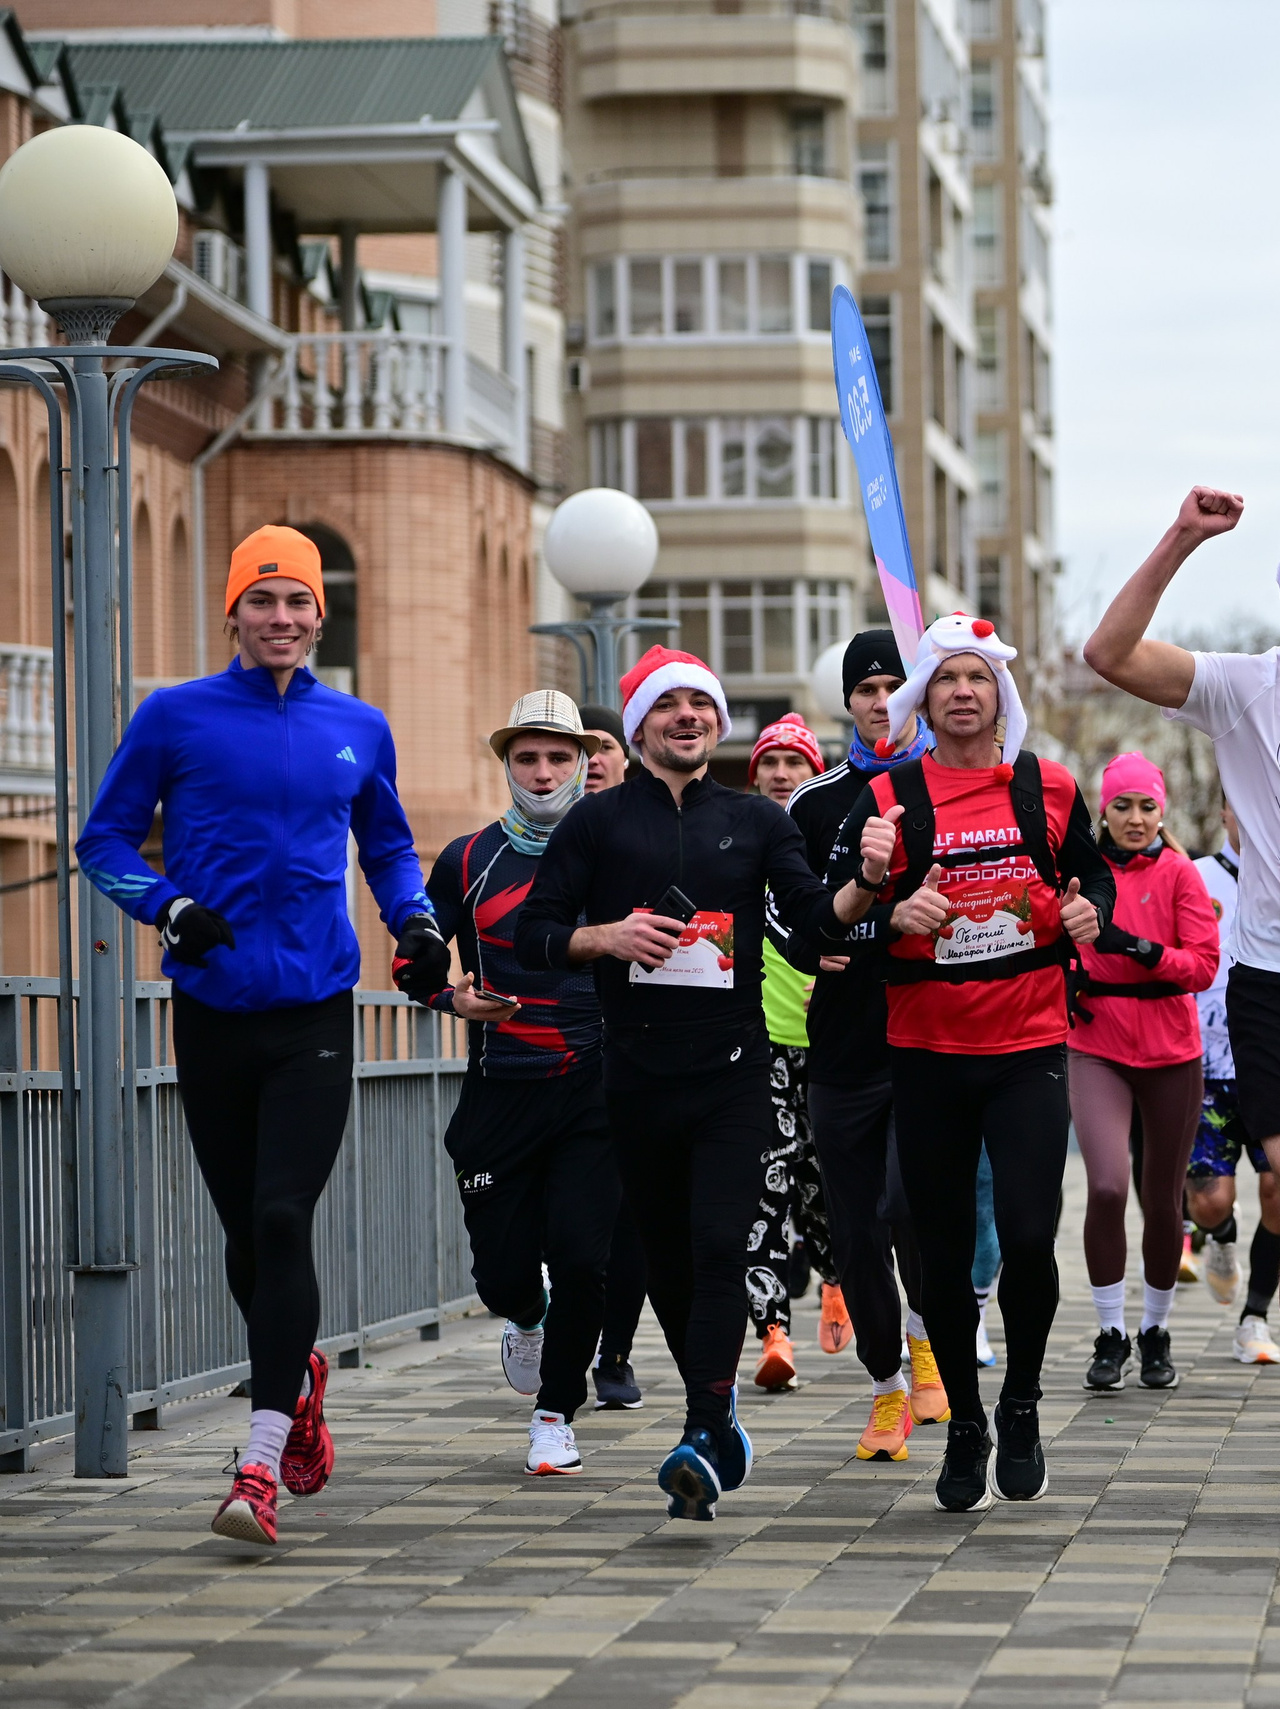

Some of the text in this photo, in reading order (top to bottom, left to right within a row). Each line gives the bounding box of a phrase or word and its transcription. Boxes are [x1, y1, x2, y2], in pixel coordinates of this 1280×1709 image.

[992, 892, 1012, 906] забег
[697, 921, 718, 934] забег
[956, 924, 1007, 944] Георгий
[986, 944, 992, 954] в
